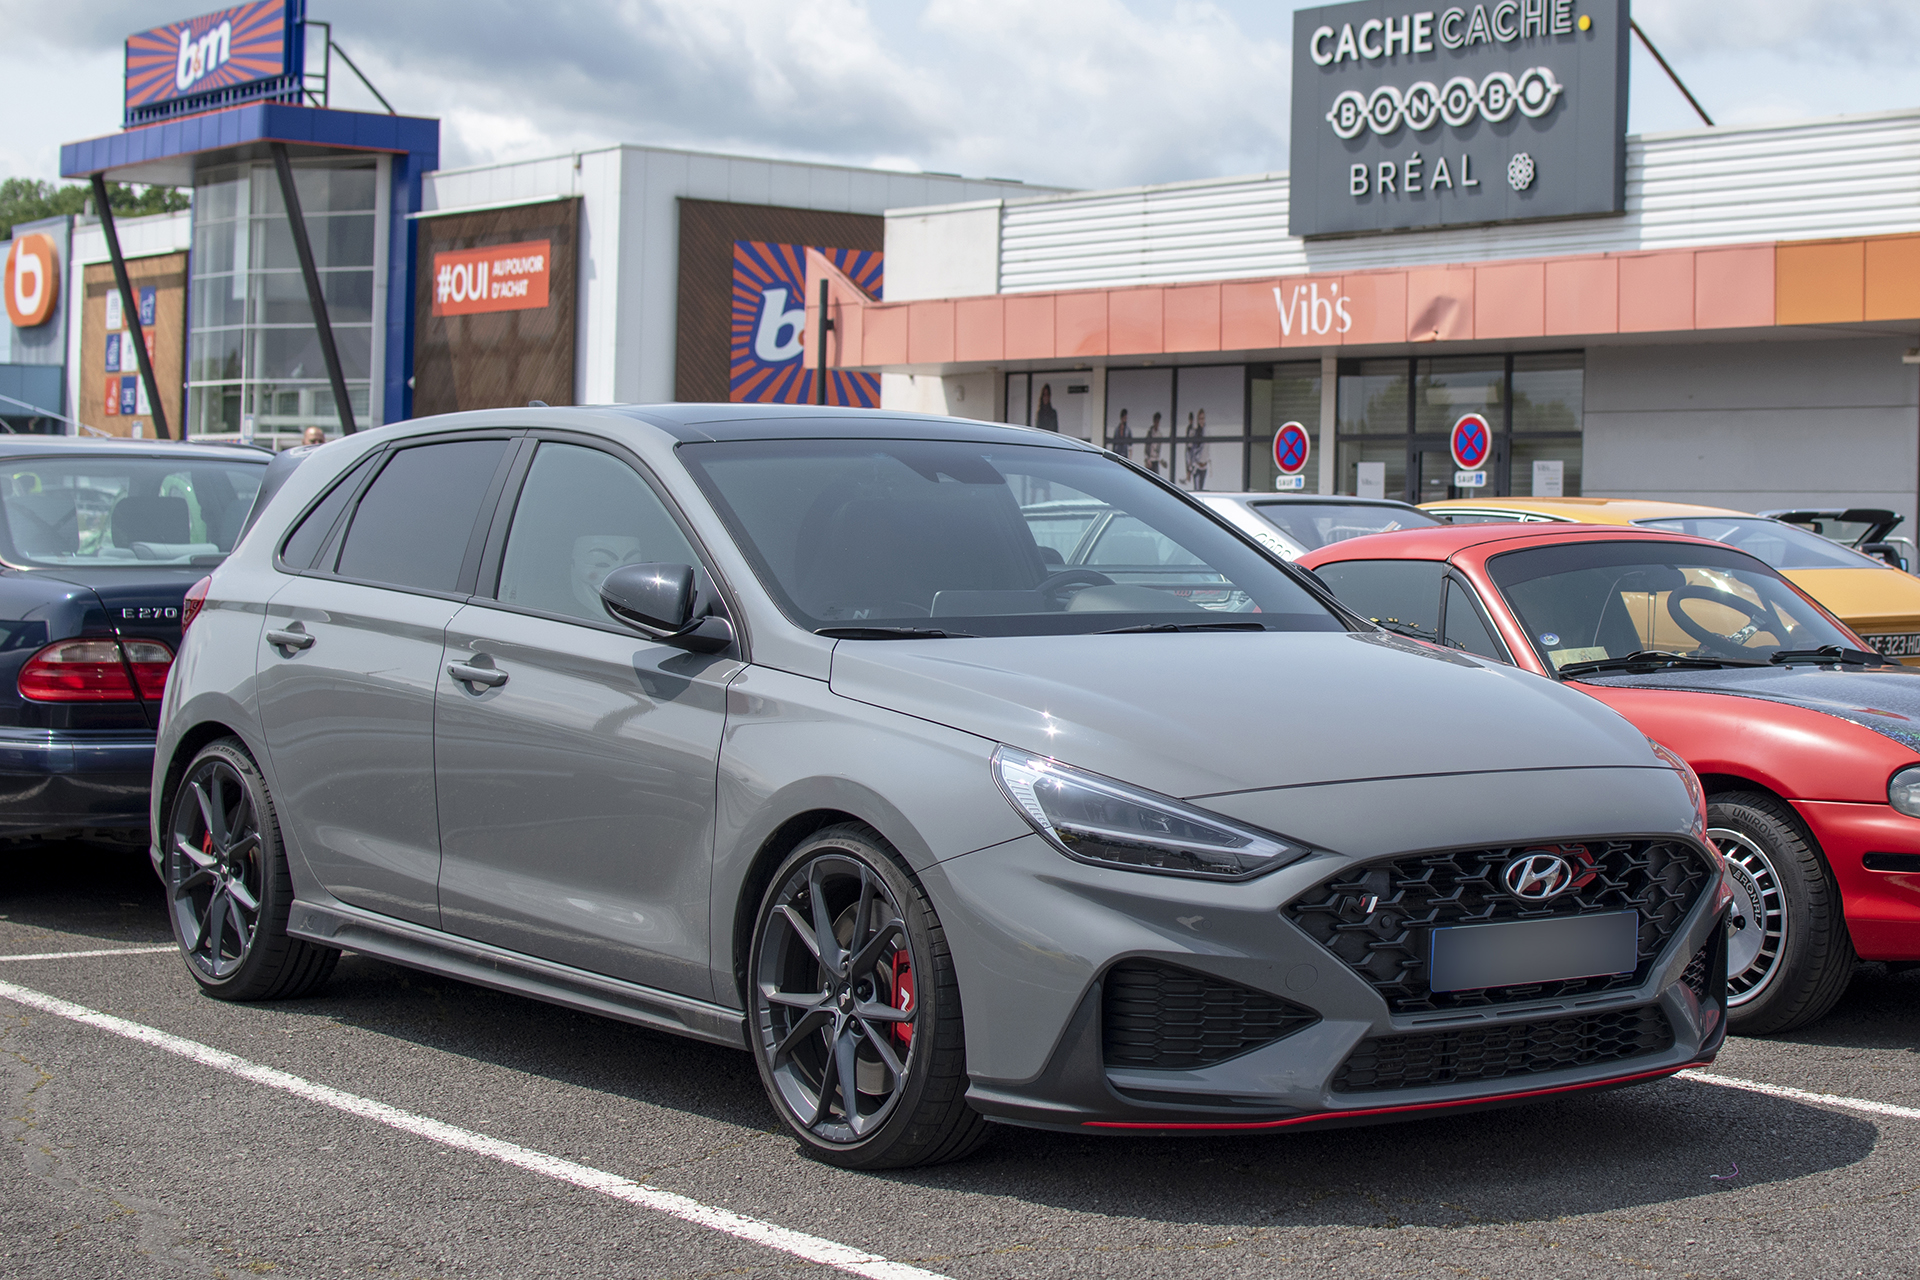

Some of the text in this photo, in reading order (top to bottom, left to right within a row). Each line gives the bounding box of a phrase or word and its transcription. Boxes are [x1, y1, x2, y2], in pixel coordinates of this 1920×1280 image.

[1310, 12, 1434, 66] CACHE
[1331, 66, 1558, 139] BONOBO
[1350, 151, 1478, 195] BRÉAL
[437, 261, 488, 304] #OUI
[491, 279, 528, 299] D'ACHAT
[1273, 283, 1352, 336] Vib's
[1457, 475, 1475, 484] SAUF
[122, 607, 178, 618] E 270
[1732, 807, 1783, 851] UNIROYAL
